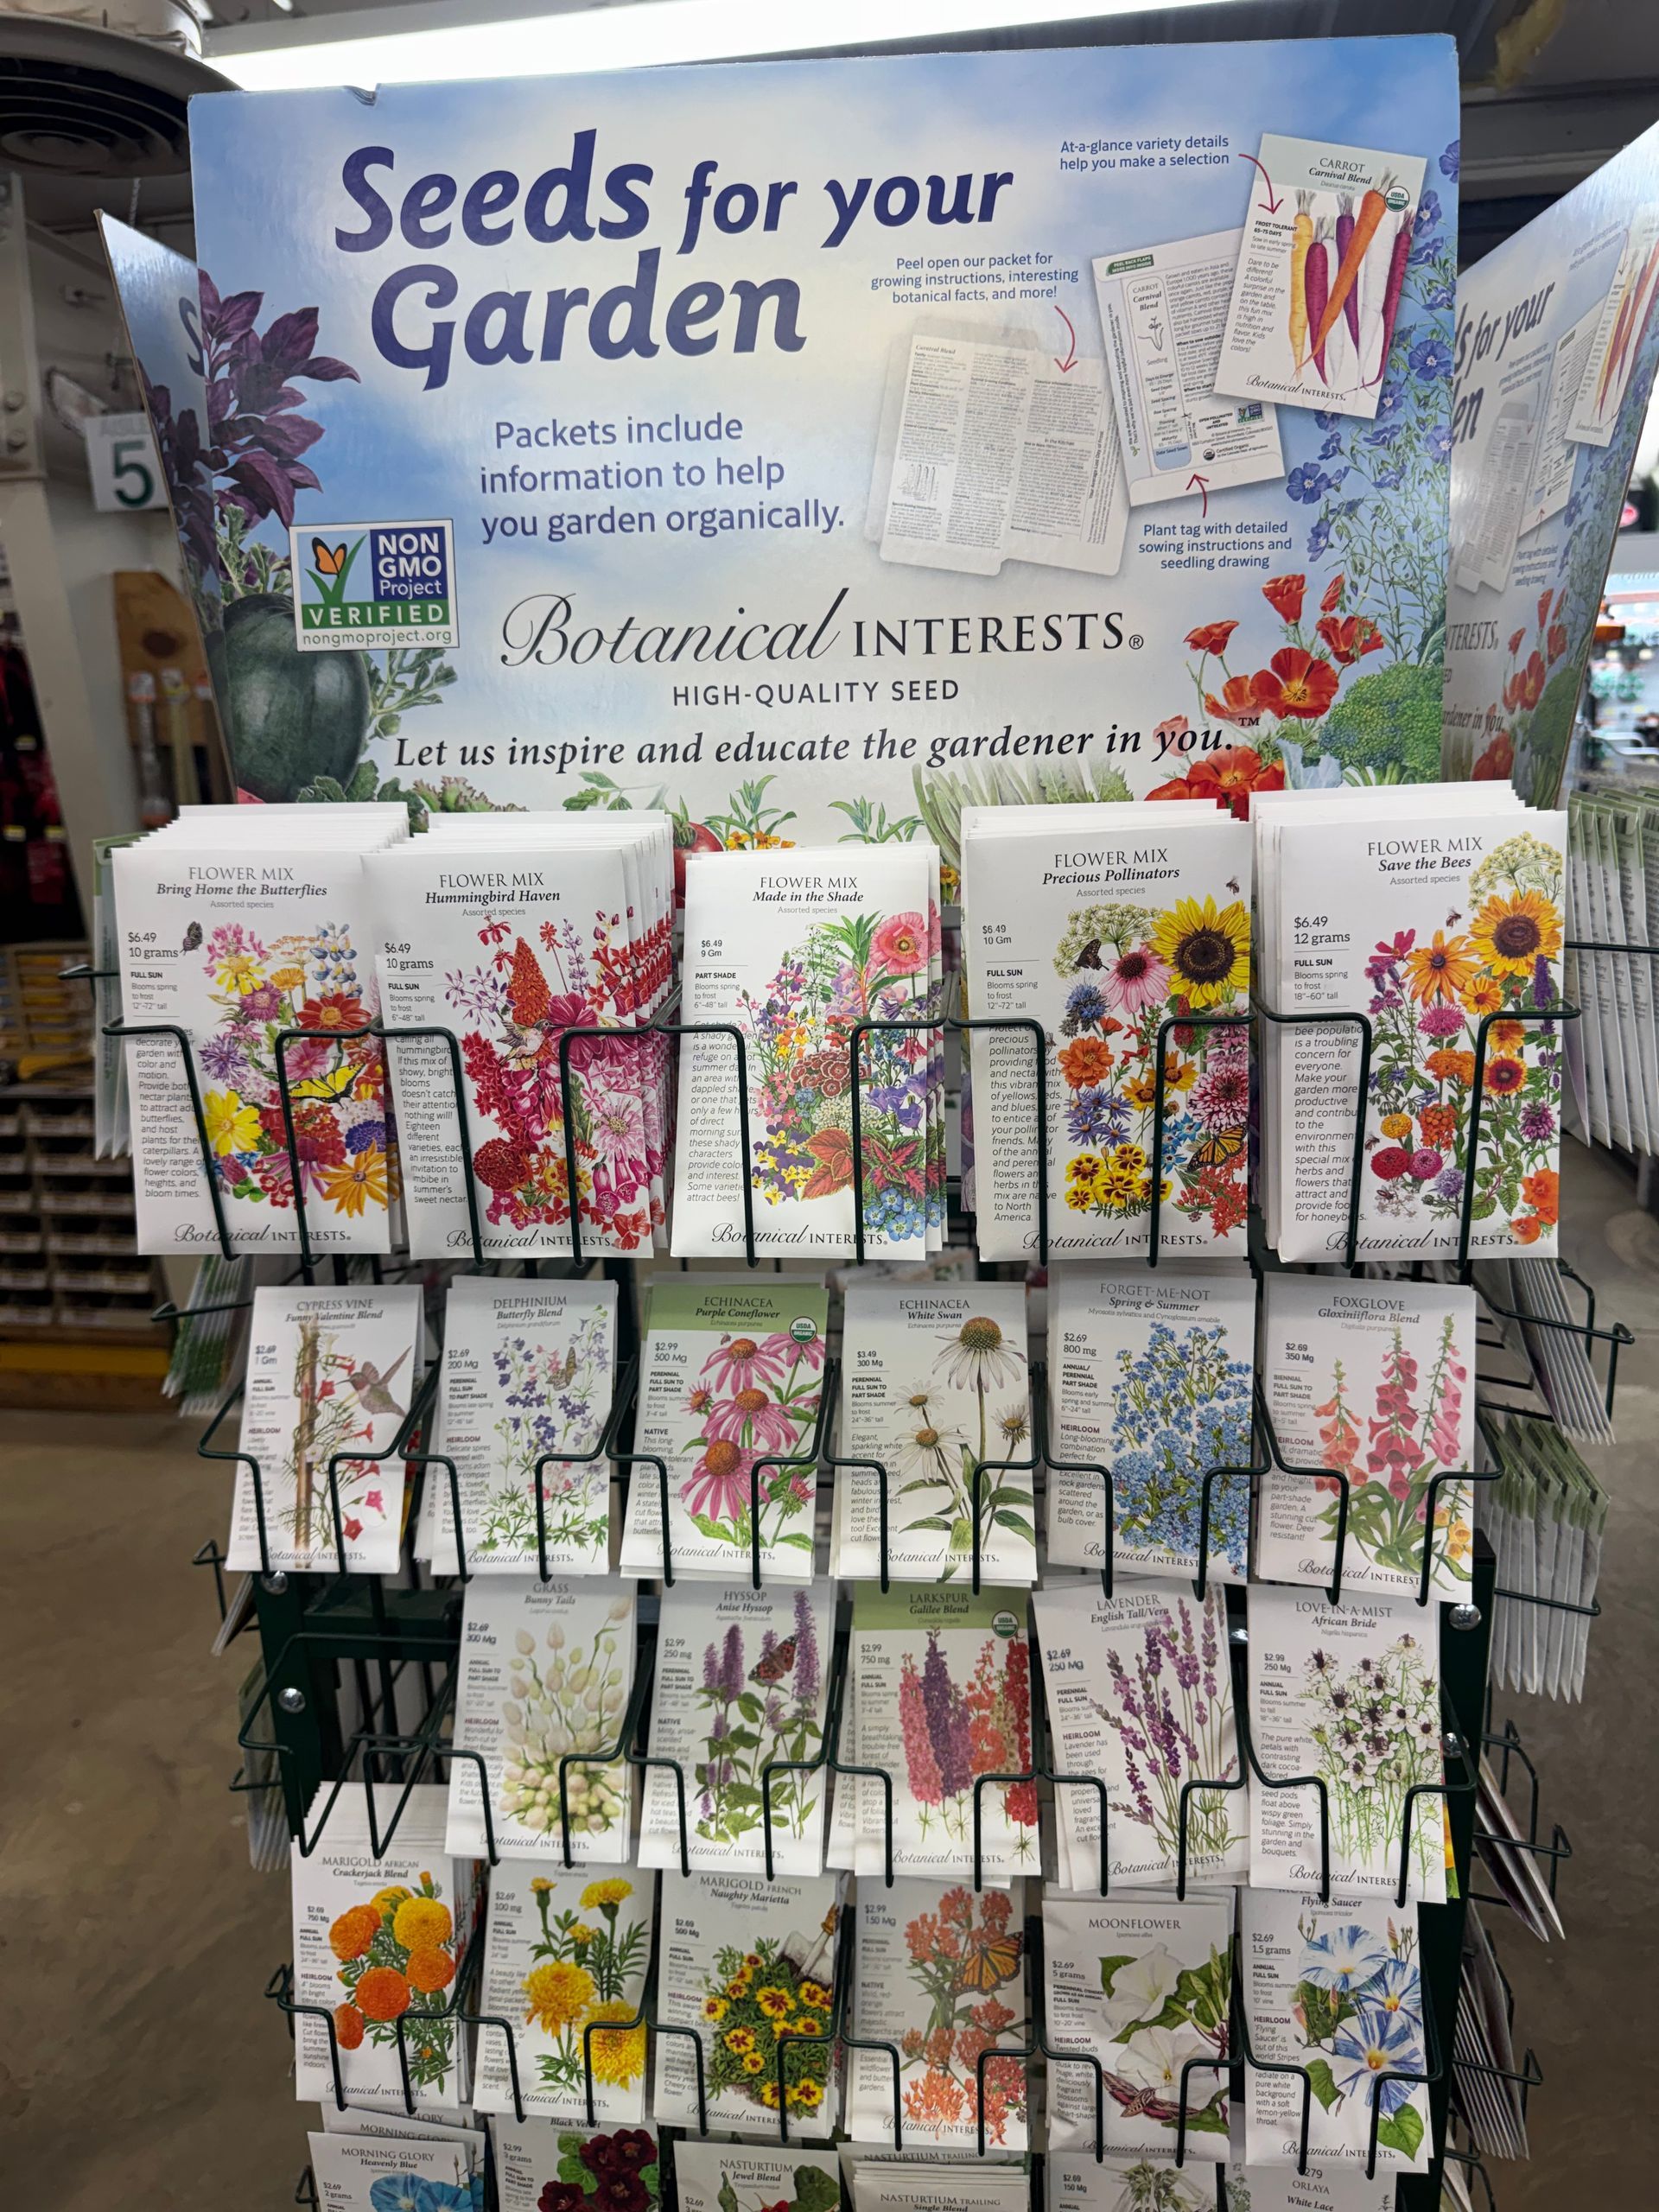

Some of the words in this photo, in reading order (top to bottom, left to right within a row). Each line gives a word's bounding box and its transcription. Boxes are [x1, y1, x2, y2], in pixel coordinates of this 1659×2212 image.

[1060, 140, 1132, 155] At-a-glance
[1136, 137, 1181, 151] variety
[1185, 136, 1229, 148] details
[1060, 158, 1088, 172] help
[1091, 158, 1115, 171] you
[1120, 156, 1154, 167] make
[1159, 157, 1166, 166] a
[1170, 153, 1229, 165] selection
[1319, 157, 1365, 173] CARROT
[1308, 168, 1345, 180] Carnival
[1347, 175, 1372, 184] Blend
[335, 129, 653, 252] Seeds
[677, 161, 798, 254] for
[821, 170, 1014, 248] your
[897, 257, 923, 270] Peel
[928, 257, 959, 270] open
[963, 257, 985, 266] our
[989, 253, 1031, 268] packet
[1035, 252, 1052, 264] for
[871, 275, 922, 290] growing
[925, 271, 1005, 285] instructions,
[1009, 269, 1078, 283] interesting
[893, 289, 950, 302] botanical
[955, 289, 988, 302] facts,
[992, 288, 1015, 300] and
[1020, 286, 1057, 299] more!
[371, 247, 806, 391] Garden
[1465, 311, 1501, 379] for
[1495, 282, 1555, 362] your
[495, 420, 617, 449] Packets
[627, 413, 743, 442] include
[112, 441, 153, 508] 5
[480, 462, 663, 493] information
[673, 464, 705, 486] to
[715, 456, 785, 492] help
[481, 513, 537, 544] you
[547, 505, 655, 543] garden
[667, 499, 845, 537] organically.
[1144, 524, 1176, 536] Plant
[1181, 525, 1200, 537] tag
[1205, 523, 1231, 534] with
[1236, 521, 1287, 533] detailed
[377, 532, 440, 556] NON
[1139, 542, 1184, 554] sowing
[1187, 540, 1264, 551] instructions
[1268, 538, 1292, 550] and
[378, 555, 442, 580] GMO
[1161, 557, 1215, 570] seedling
[1218, 556, 1269, 569] drawing
[379, 578, 442, 601] Project
[309, 603, 444, 627] VERIFIED
[500, 588, 849, 666] Botanical
[303, 627, 452, 647] nongmoproject.org
[673, 682, 879, 707] HIGH-QUALITY
[891, 680, 959, 702] SEED
[395, 738, 448, 766] Let
[459, 741, 495, 766] us
[508, 736, 625, 774] inspire
[637, 733, 702, 764] and
[715, 731, 849, 763] educate
[863, 728, 916, 760] the
[926, 727, 1094, 768] gardener
[1106, 724, 1141, 754] in
[1367, 839, 1443, 855] FLOWER
[1448, 836, 1483, 852] MIX
[1054, 852, 1128, 868] FLOWER
[1134, 848, 1168, 863] MIX
[1378, 858, 1416, 873] Save
[1421, 857, 1439, 870] the
[1441, 855, 1471, 868] Bees
[188, 868, 257, 880] FLOWER
[262, 868, 294, 880] MIX
[440, 874, 507, 888] FLOWER
[512, 873, 544, 887] MIX
[1043, 870, 1101, 887] Precious
[1105, 867, 1180, 881] Pollinators
[156, 883, 192, 897] Bring
[195, 884, 232, 896] Home
[237, 883, 257, 896] the
[260, 883, 327, 898] Butterflies
[760, 877, 823, 889] FLOWER
[829, 877, 858, 888] MIX
[425, 890, 516, 904] Hummingbird
[518, 889, 561, 902] Haven
[753, 891, 788, 902] Made
[791, 892, 802, 902] in
[805, 892, 823, 902] the
[828, 891, 863, 902] Shade
[982, 924, 1007, 935] $6.49
[1294, 916, 1328, 930] $6.49
[128, 931, 156, 943] $6.49
[1100, 1283, 1210, 1300] FORGET-ME-NOT
[296, 1300, 343, 1312] CYPRESS
[345, 1299, 373, 1309] VINE
[493, 1296, 567, 1309] DELPHINIUM
[704, 1297, 772, 1307] ECHINACEA
[899, 1300, 970, 1309] ECHINACEA
[1109, 1297, 1141, 1310] Spring
[1145, 1300, 1154, 1308] &
[1156, 1300, 1199, 1312] Summer
[1333, 1297, 1405, 1312] FOXGLOVE
[285, 1313, 313, 1322] Funny
[315, 1311, 355, 1320] Valentine
[357, 1310, 383, 1319] Blend
[496, 1310, 535, 1320] Butterfly
[537, 1308, 563, 1318] Blend
[696, 1308, 725, 1318] Purple
[728, 1308, 780, 1319] Coneflower
[907, 1311, 936, 1319] White
[1318, 1308, 1387, 1322] Gloxiniiflora
[1389, 1313, 1420, 1323] Blend
[533, 1584, 569, 1593] GRASS
[724, 1591, 766, 1600] HYSSOP
[524, 1595, 554, 1605] Bunny
[556, 1596, 575, 1605] Tails
[910, 1593, 969, 1604] LARKSPUR
[1097, 1594, 1160, 1611] LAVENDER
[715, 1603, 740, 1611] Anise
[742, 1604, 772, 1614] Hyssop
[910, 1605, 940, 1615] Galilee
[944, 1605, 969, 1614] Blend
[1090, 1611, 1125, 1624] English
[1312, 1616, 1347, 1628] African
[1350, 1618, 1376, 1629] Bride
[323, 1856, 382, 1868] MARIGOLD
[333, 1868, 381, 1878] Crackerjack
[385, 1870, 409, 1879] Blend
[700, 1876, 764, 1891] MARIGOLD
[766, 1885, 801, 1895] FRENCH
[710, 1889, 748, 1902] Naughty
[751, 1893, 790, 1904] Marietta
[1089, 1918, 1181, 1929] MOONFLOWER
[342, 2148, 396, 2158] MORNING
[399, 2152, 435, 2161] GLORY
[360, 2158, 397, 2168] Heavenly
[720, 2159, 793, 2173] NASTURTIUM
[732, 2171, 753, 2181] Jewel
[757, 2173, 781, 2182] Blend
[1292, 2180, 1330, 2195] ORLAYA
[880, 2194, 957, 2204] NASTURTIUM
[1287, 2196, 1312, 2208] White
[1314, 2201, 1334, 2211] Lace
